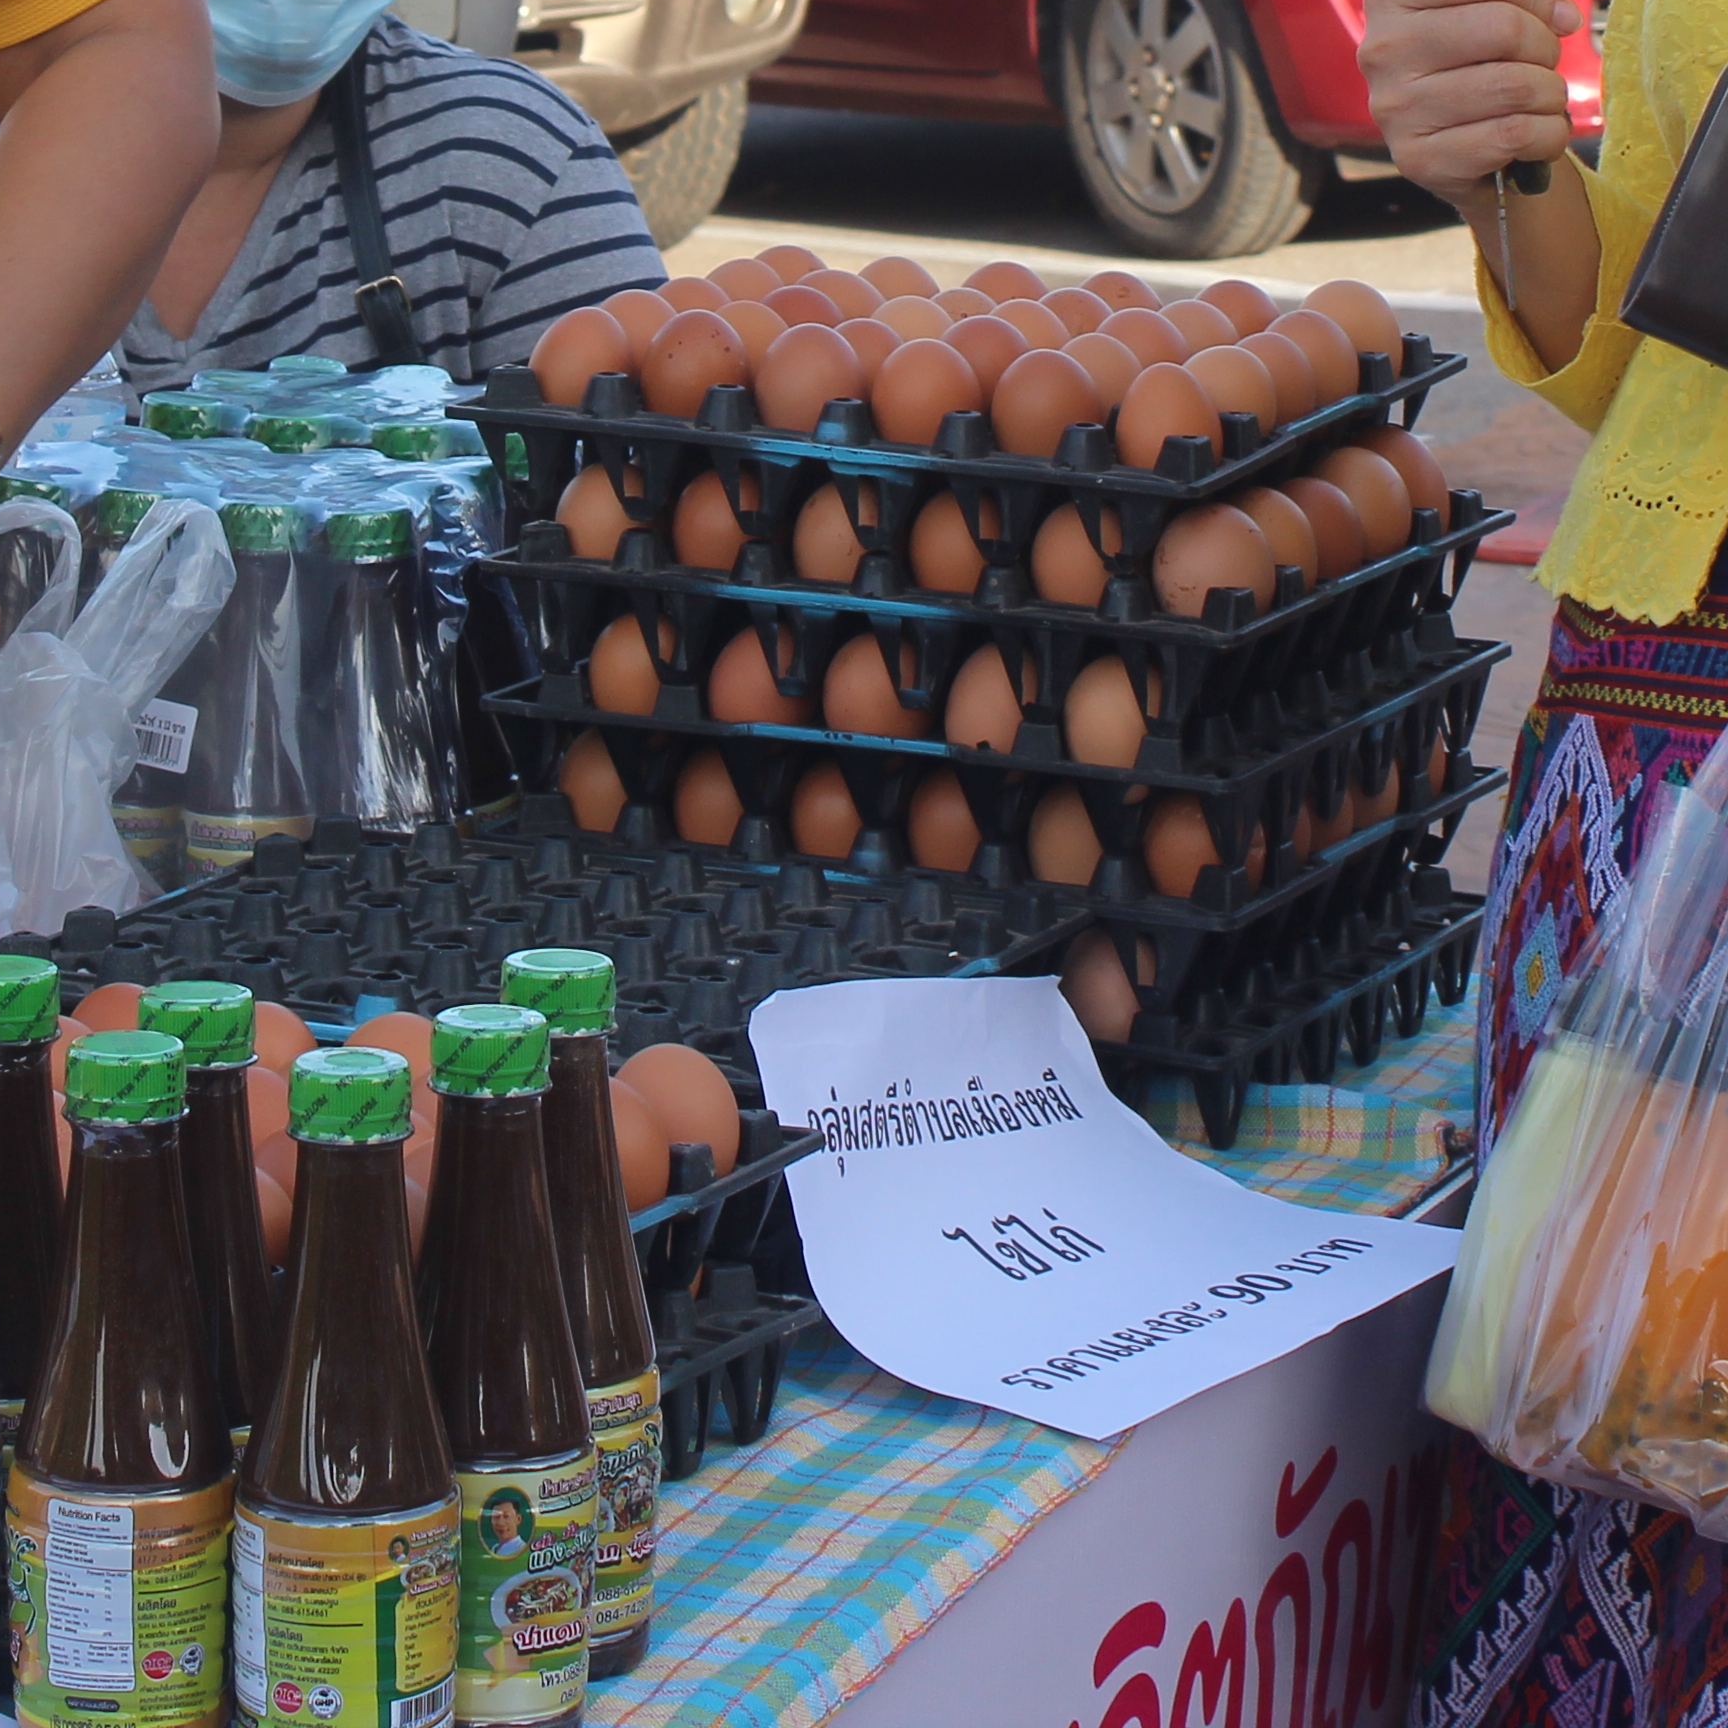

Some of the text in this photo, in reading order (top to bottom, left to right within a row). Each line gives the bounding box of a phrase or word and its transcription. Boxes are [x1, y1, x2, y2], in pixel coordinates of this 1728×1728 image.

[943, 1206, 1105, 1287] ไข่ไก่
[1001, 1234, 1374, 1394] ราคาแผงละ 90 บาท
[58, 1505, 121, 1523] Nutrition Facts
[138, 1598, 177, 1611] ผลิตโดย
